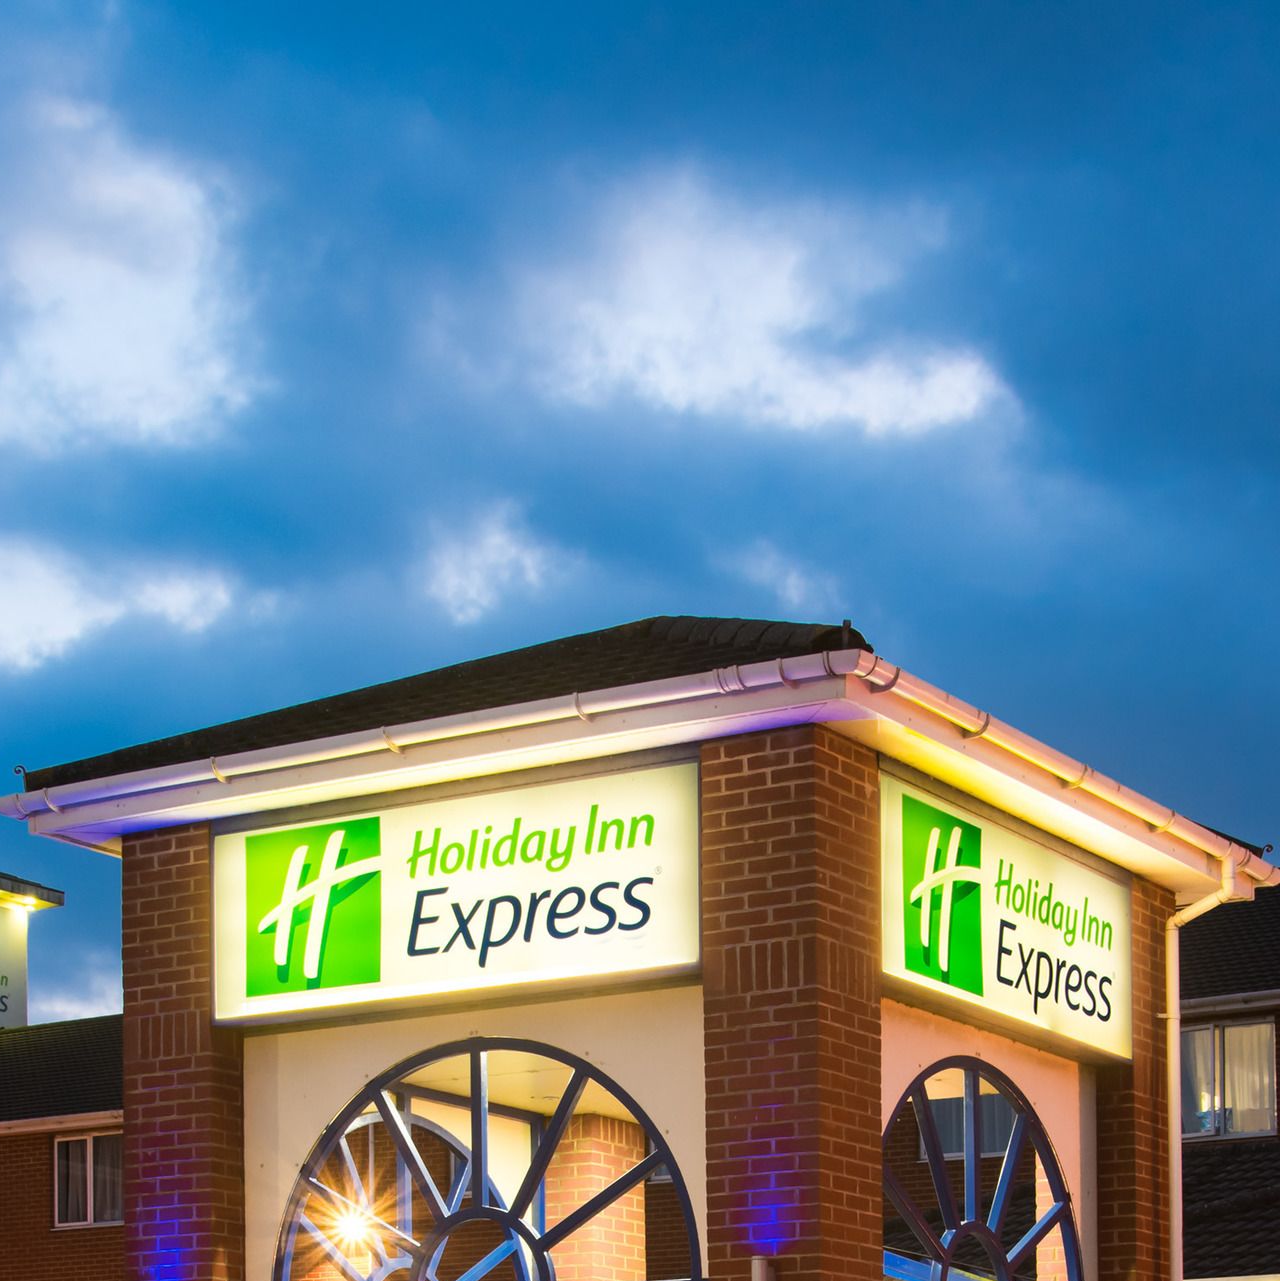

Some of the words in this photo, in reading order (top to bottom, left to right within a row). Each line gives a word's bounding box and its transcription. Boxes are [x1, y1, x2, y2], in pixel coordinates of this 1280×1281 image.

[406, 816, 577, 879] Holiday
[585, 804, 655, 854] Inn
[406, 876, 654, 969] Express
[995, 858, 1078, 947] Holiday
[1081, 897, 1113, 951] Inn
[996, 918, 1113, 1023] Express
